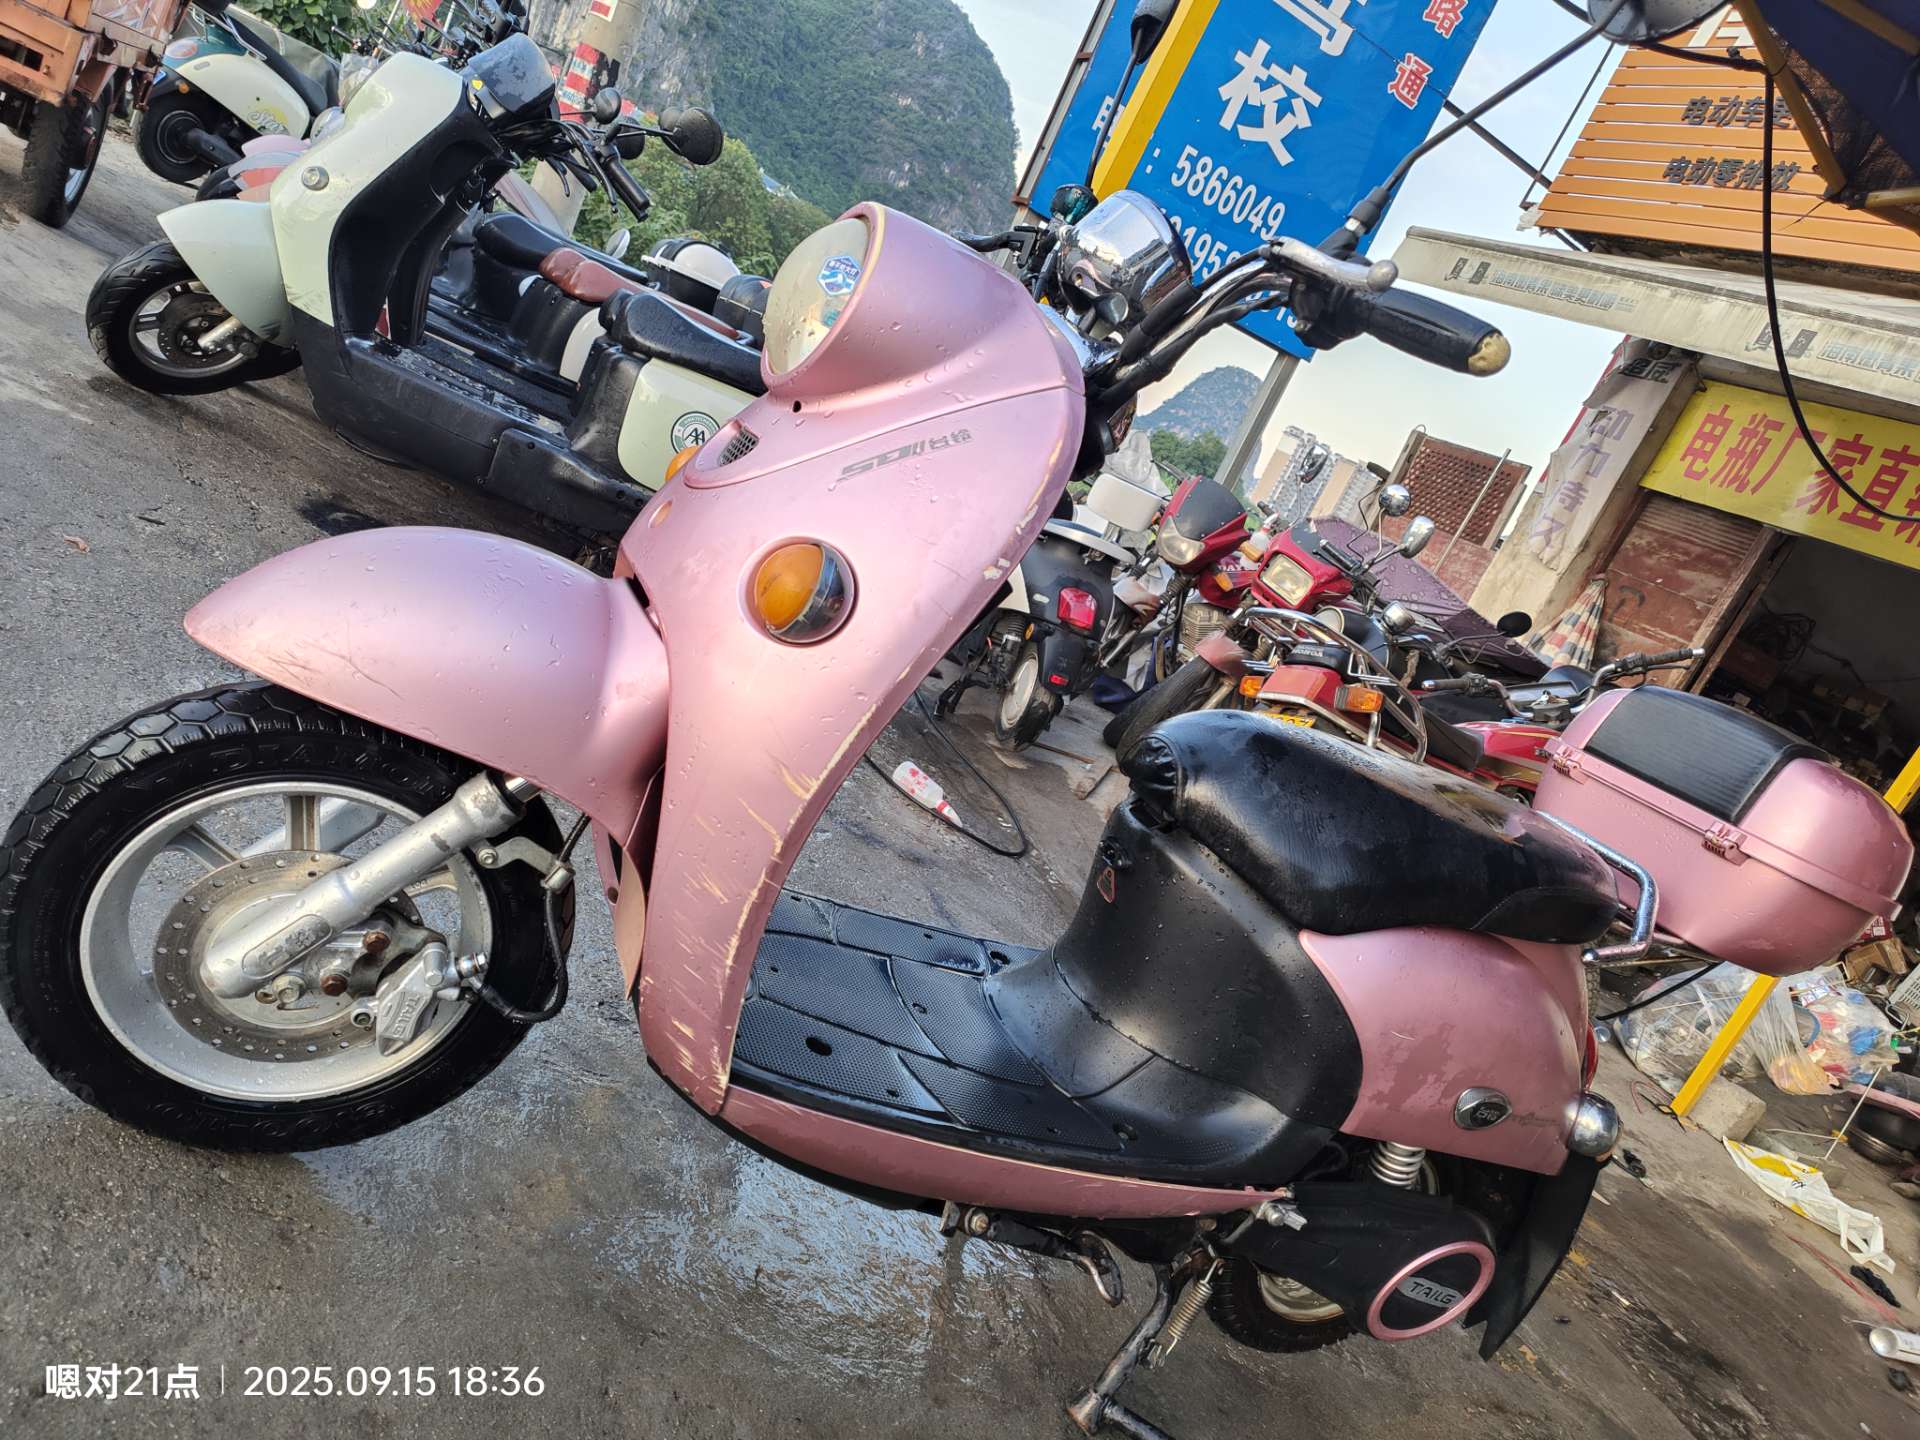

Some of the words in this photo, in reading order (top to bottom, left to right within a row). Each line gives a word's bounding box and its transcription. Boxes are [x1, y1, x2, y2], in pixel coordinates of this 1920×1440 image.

[1662, 156, 1801, 191] 电动零排放
[1410, 1281, 1457, 1305] TAILG
